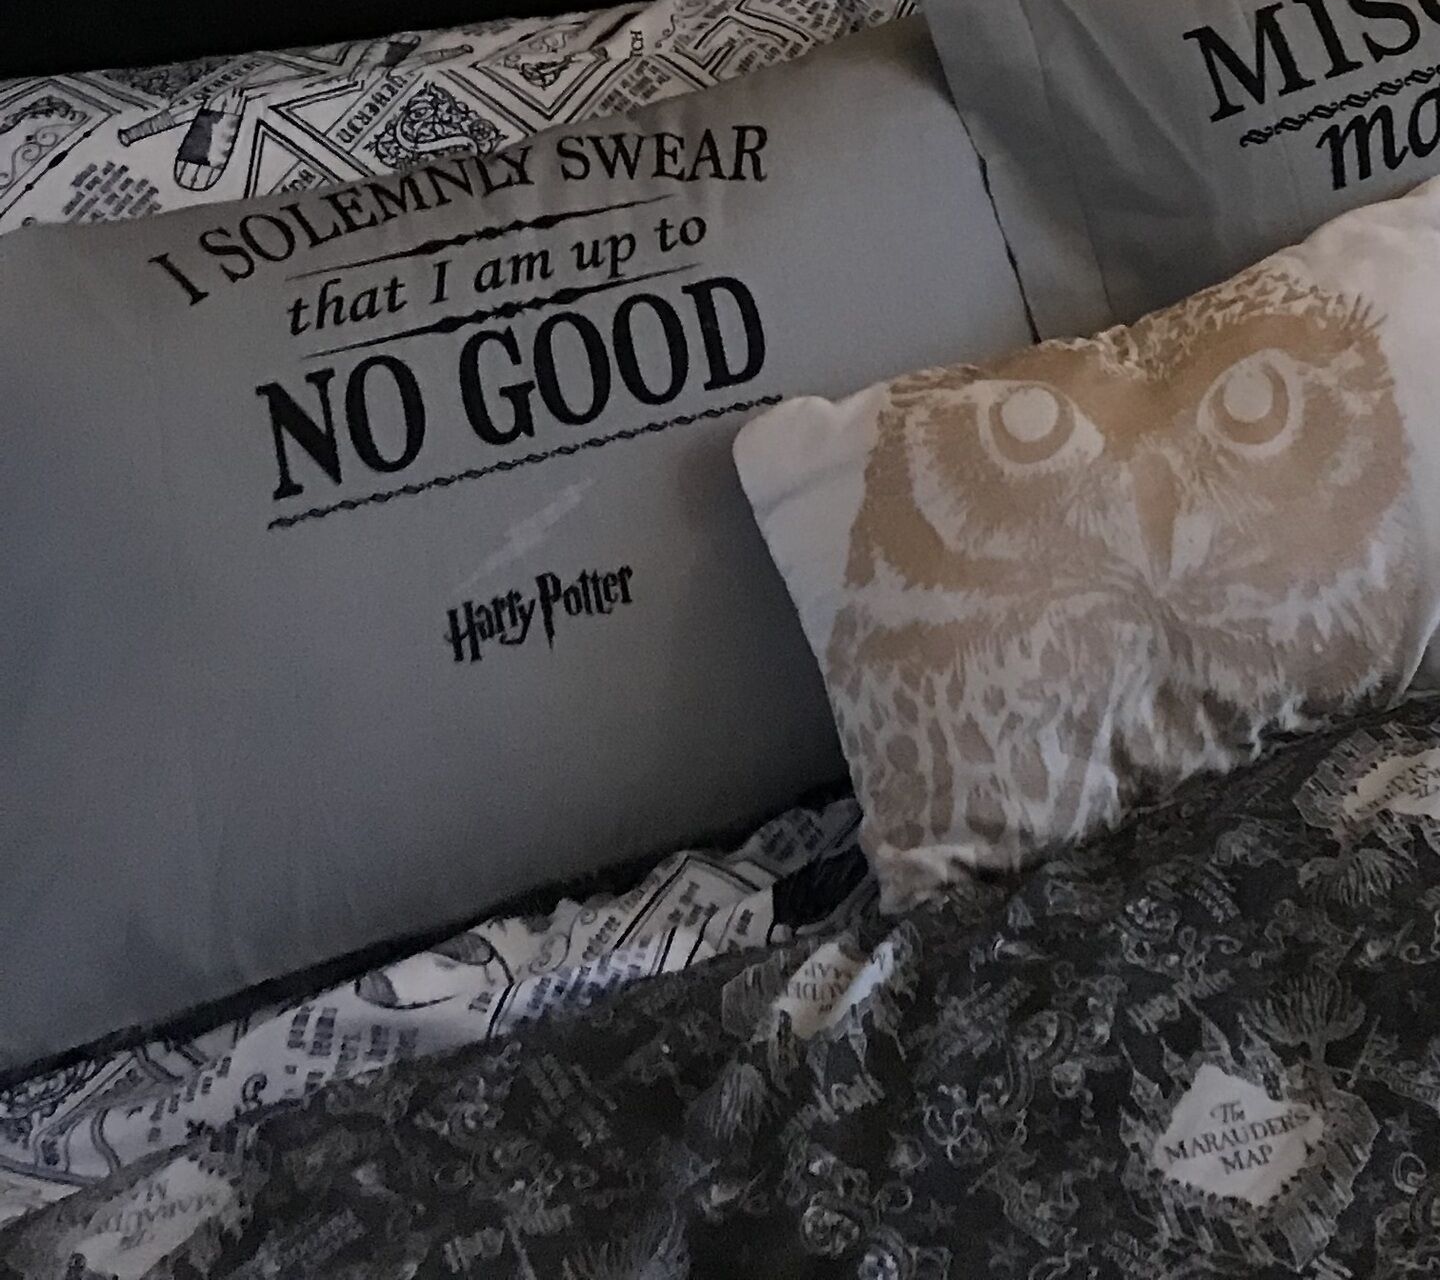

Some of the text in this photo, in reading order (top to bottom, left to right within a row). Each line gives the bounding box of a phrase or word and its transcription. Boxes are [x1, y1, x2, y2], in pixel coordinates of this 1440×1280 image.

[149, 251, 210, 306] I
[198, 146, 536, 284] SOLEMNLY
[557, 125, 768, 184] SWEAR
[288, 215, 708, 336] that I am up to
[255, 276, 766, 501] NO GOOD
[445, 565, 634, 662] Harry Potter
[1209, 1099, 1246, 1124] The
[1221, 1144, 1273, 1176] MAP
